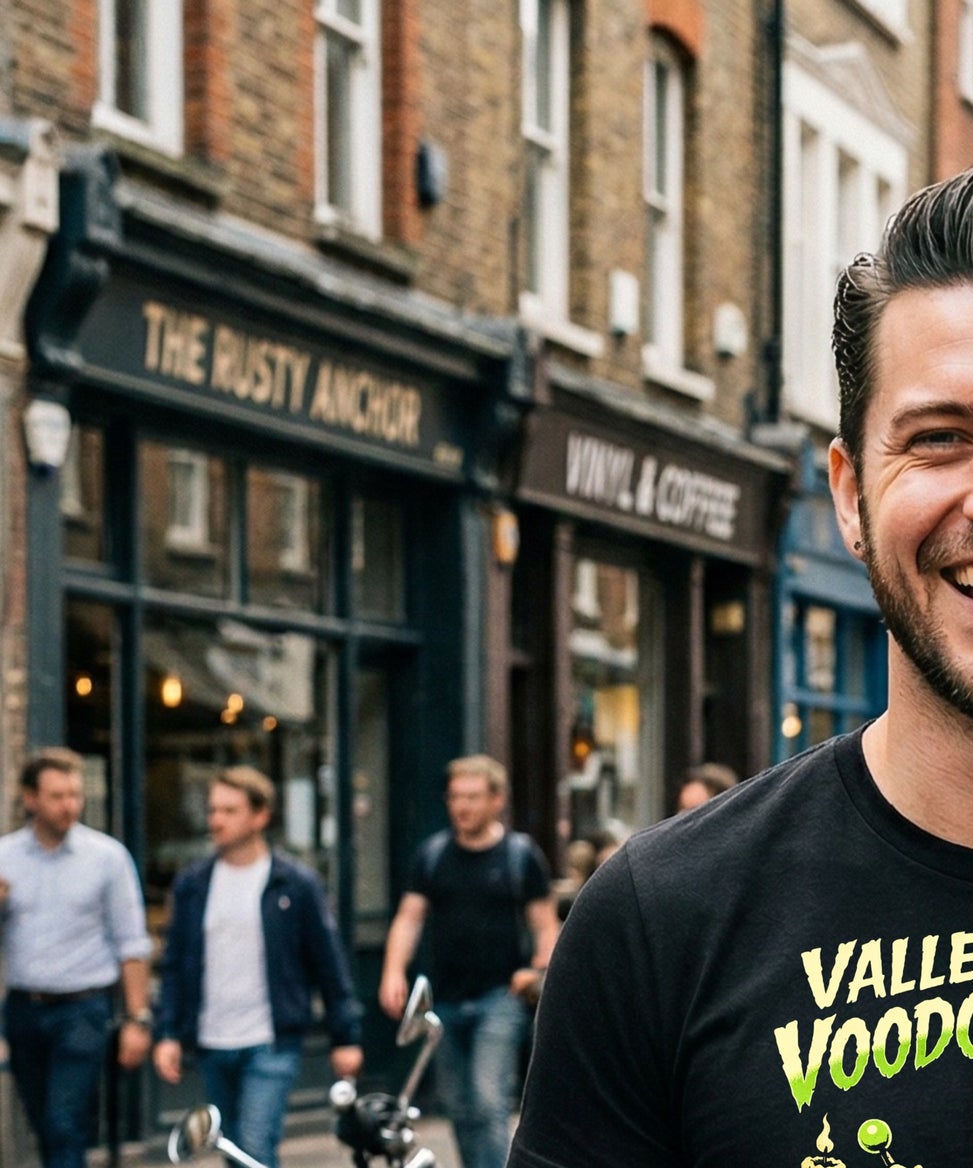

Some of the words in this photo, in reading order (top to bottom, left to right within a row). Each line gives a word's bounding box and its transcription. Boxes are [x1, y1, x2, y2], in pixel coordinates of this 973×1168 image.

[143, 301, 208, 386] THE
[211, 322, 311, 414] RUSTY
[309, 358, 422, 447] ANCHOR
[566, 430, 635, 512] VINYL
[635, 455, 658, 516] &
[656, 463, 741, 540] COFFEE
